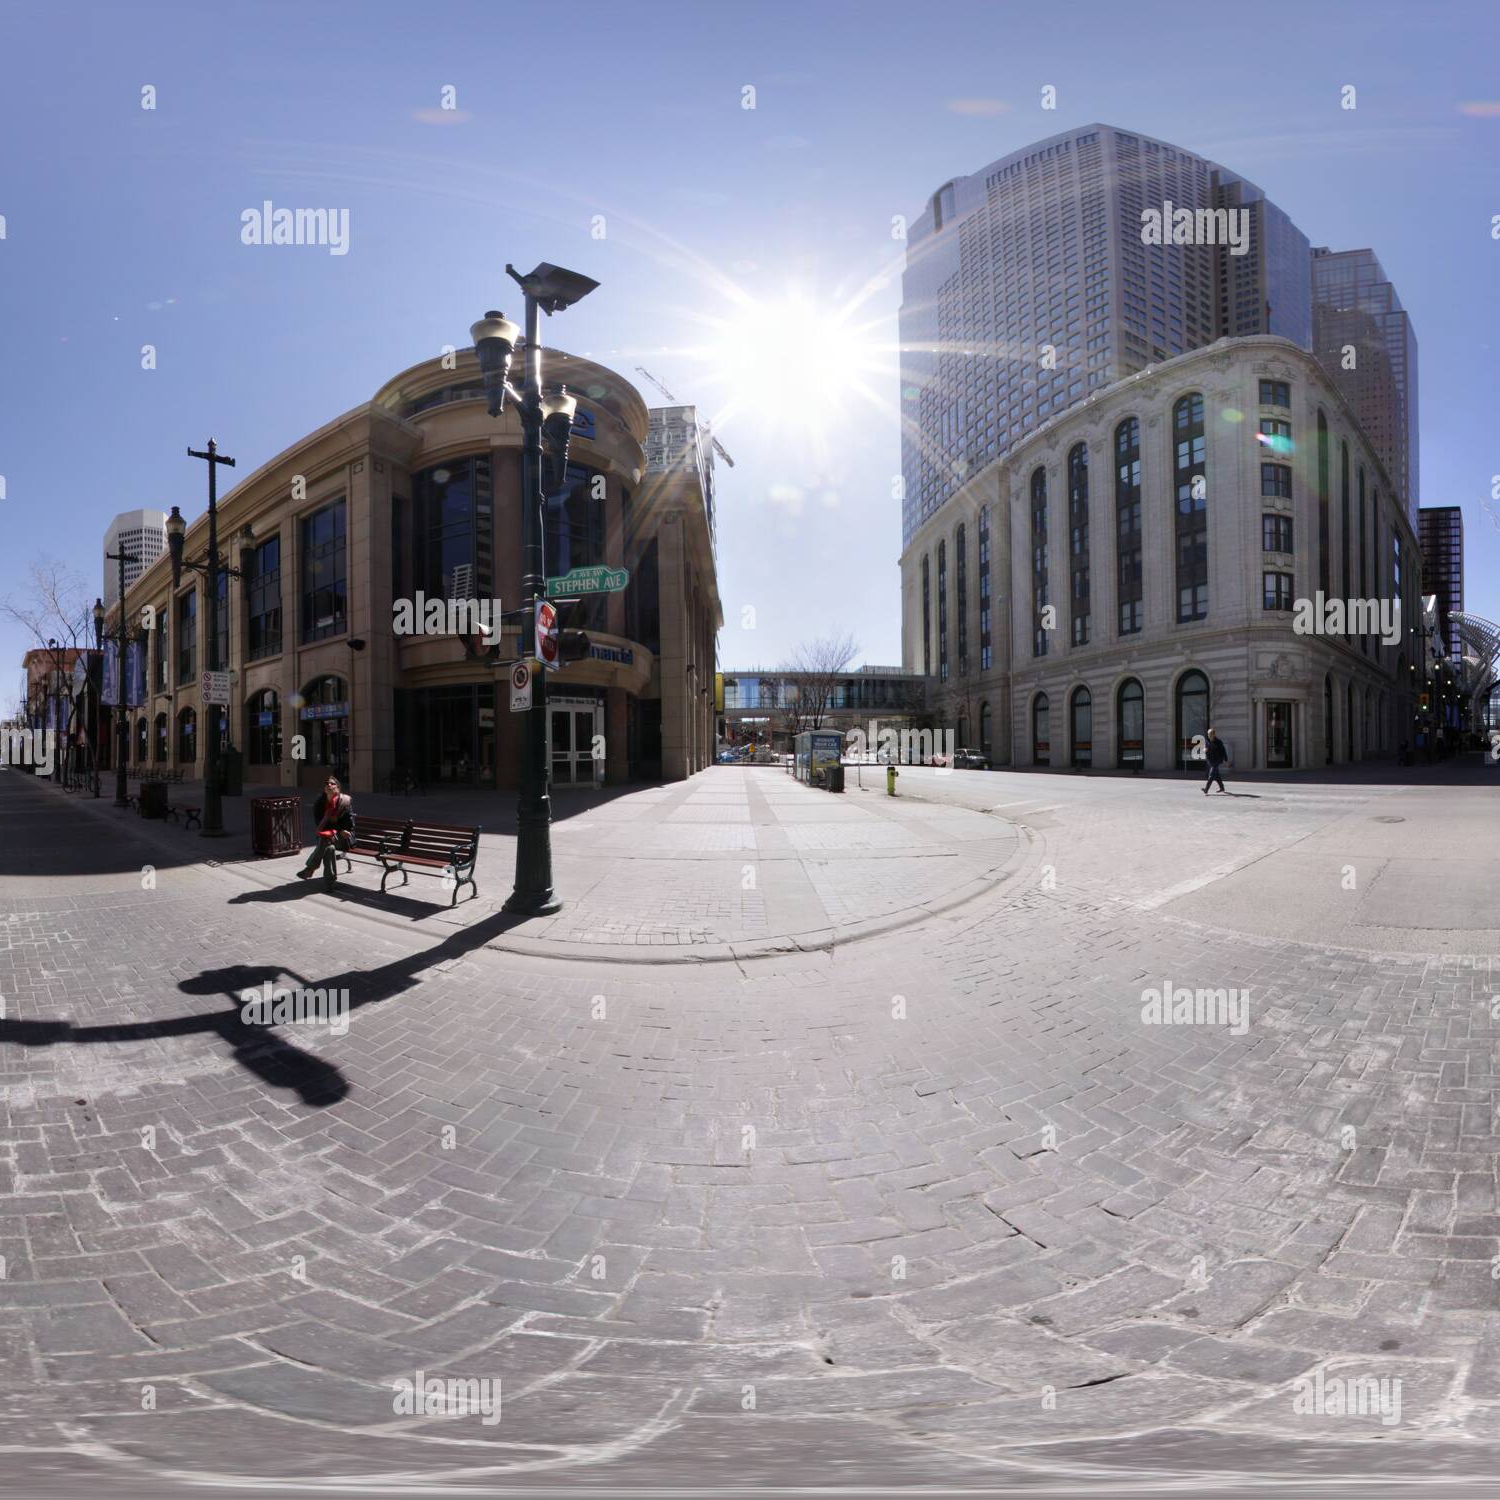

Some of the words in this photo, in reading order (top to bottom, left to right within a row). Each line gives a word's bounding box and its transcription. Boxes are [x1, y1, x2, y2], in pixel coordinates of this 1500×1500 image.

[555, 577, 600, 593] STEPHEN
[603, 574, 621, 588] AVE
[590, 646, 633, 664] nancial
